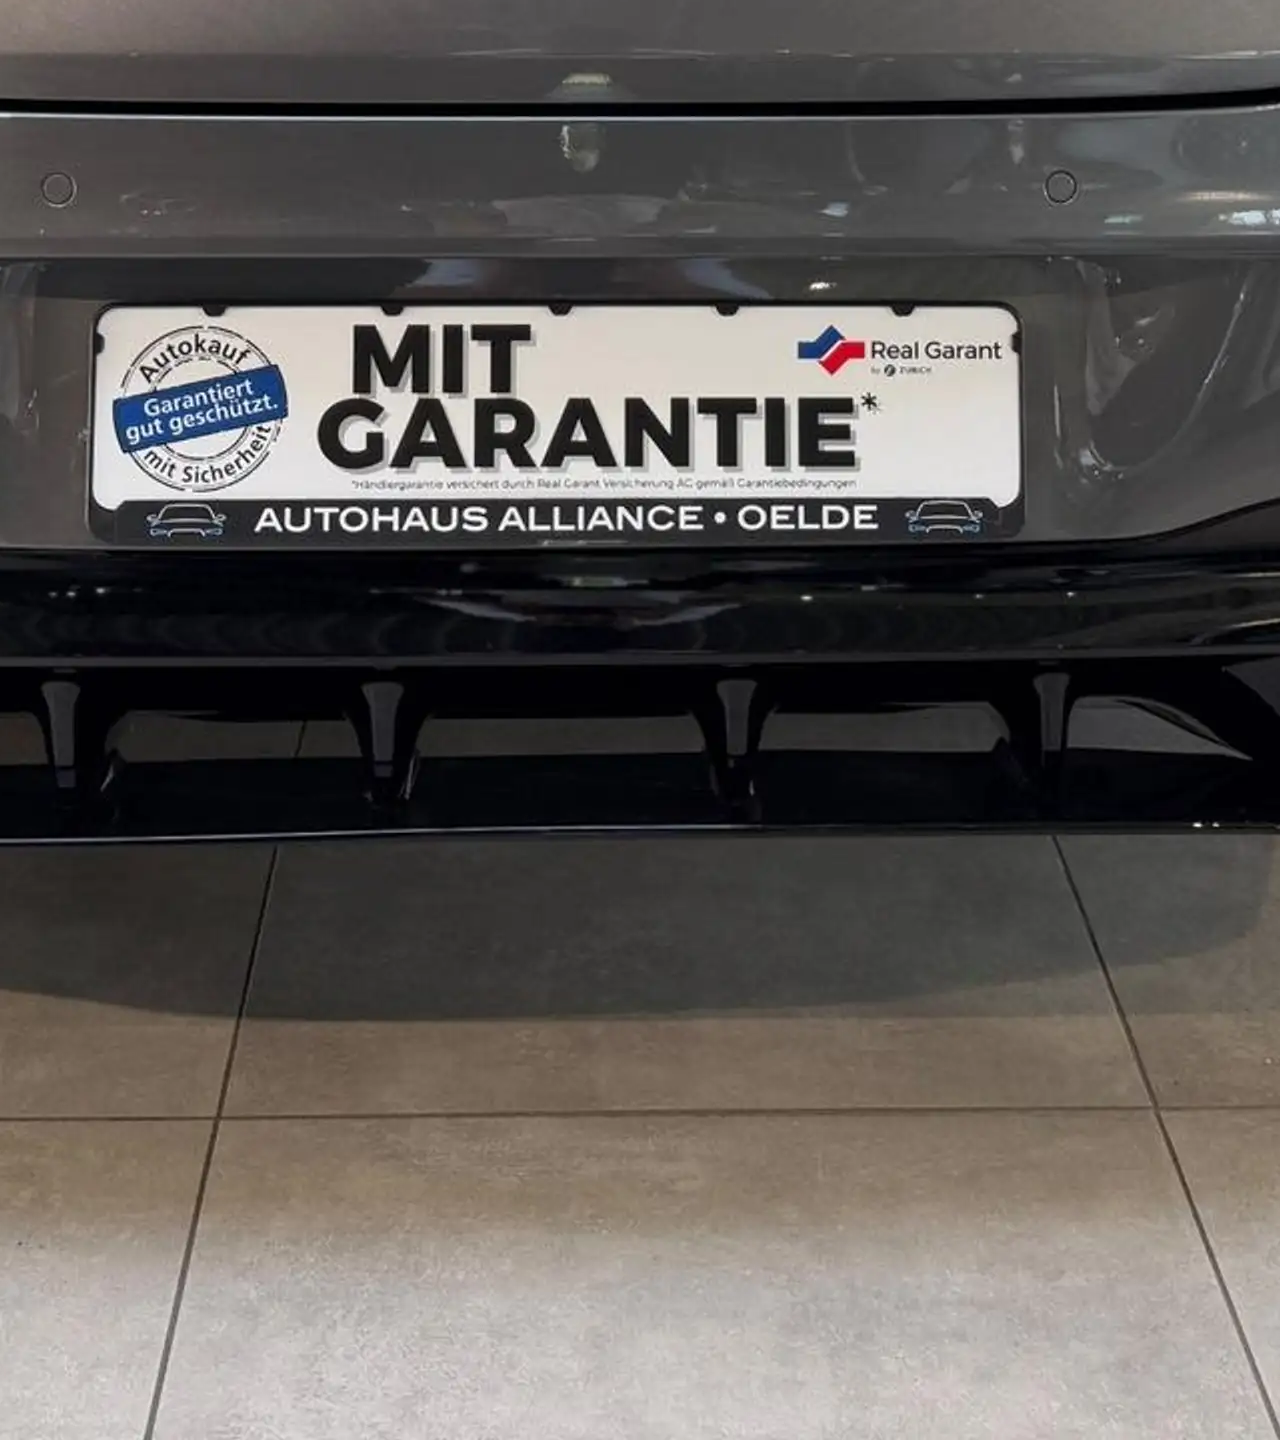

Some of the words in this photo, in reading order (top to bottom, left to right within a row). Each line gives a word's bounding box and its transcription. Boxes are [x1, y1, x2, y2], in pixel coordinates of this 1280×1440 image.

[140, 334, 251, 383] Autokauf
[353, 324, 532, 395] MIT
[871, 340, 919, 360] Real
[924, 340, 1002, 360] Garant
[125, 420, 163, 445] gut
[169, 393, 279, 436] geschützt.
[144, 379, 254, 417] Garantiert
[144, 449, 176, 479] mit
[182, 425, 272, 484] Sicherheit
[537, 478, 561, 489] Real
[564, 478, 600, 490] Garant
[254, 505, 489, 533] AUTOHAUS
[497, 505, 704, 532] ALLIANCE
[737, 504, 879, 531] OELDE
